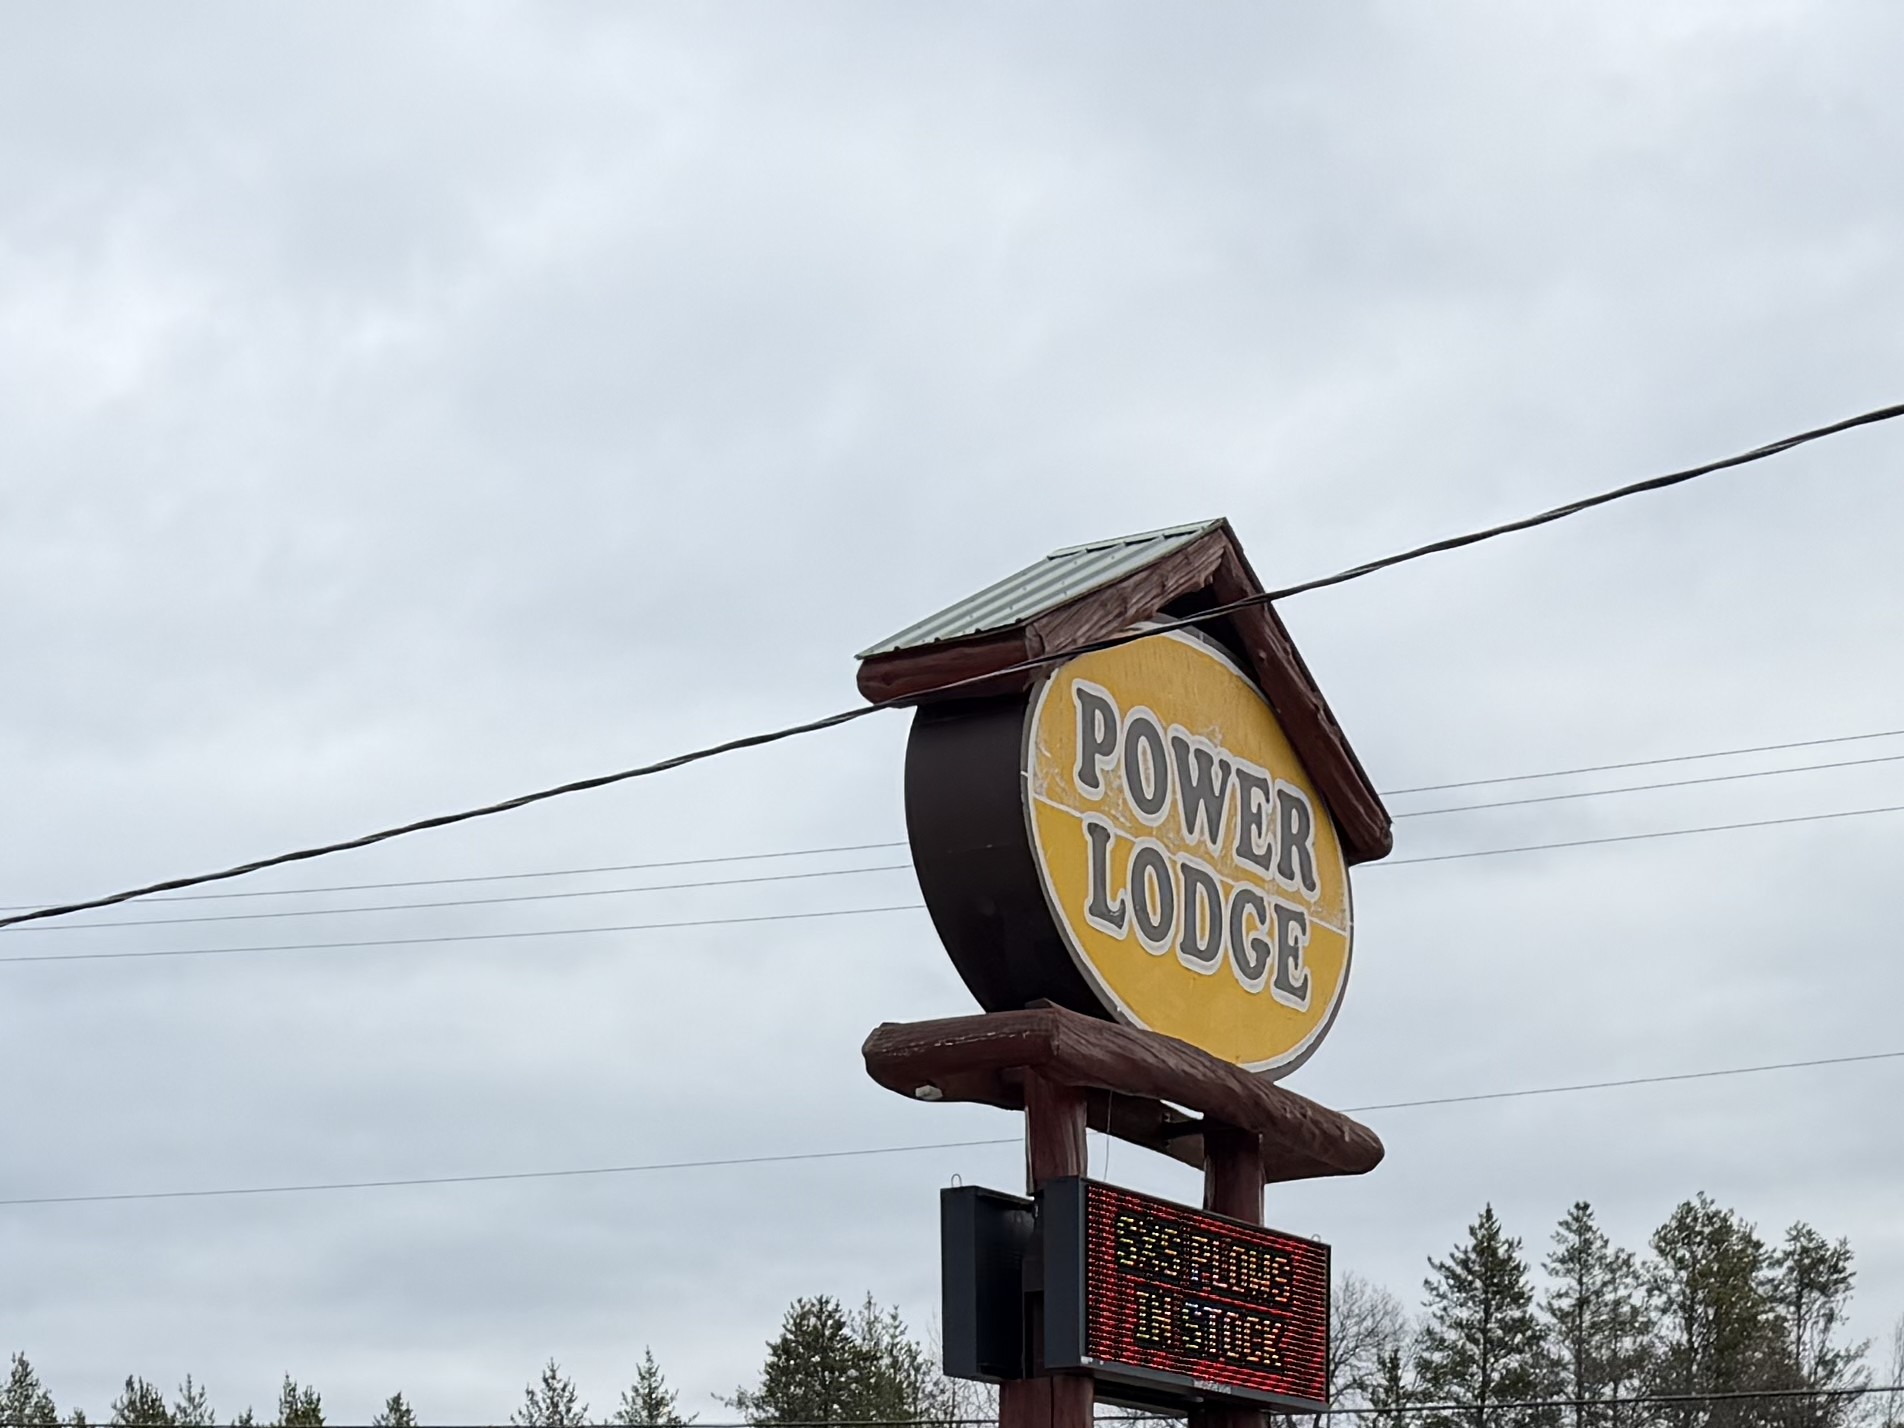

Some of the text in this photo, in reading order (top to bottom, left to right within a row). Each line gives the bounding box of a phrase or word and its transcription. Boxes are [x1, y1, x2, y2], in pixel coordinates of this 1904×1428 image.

[1074, 683, 1318, 896] POWER
[1084, 817, 1310, 1007] LODGE
[1136, 1291, 1282, 1367] IN STOCK
[1191, 1236, 1290, 1303] PLOWS
